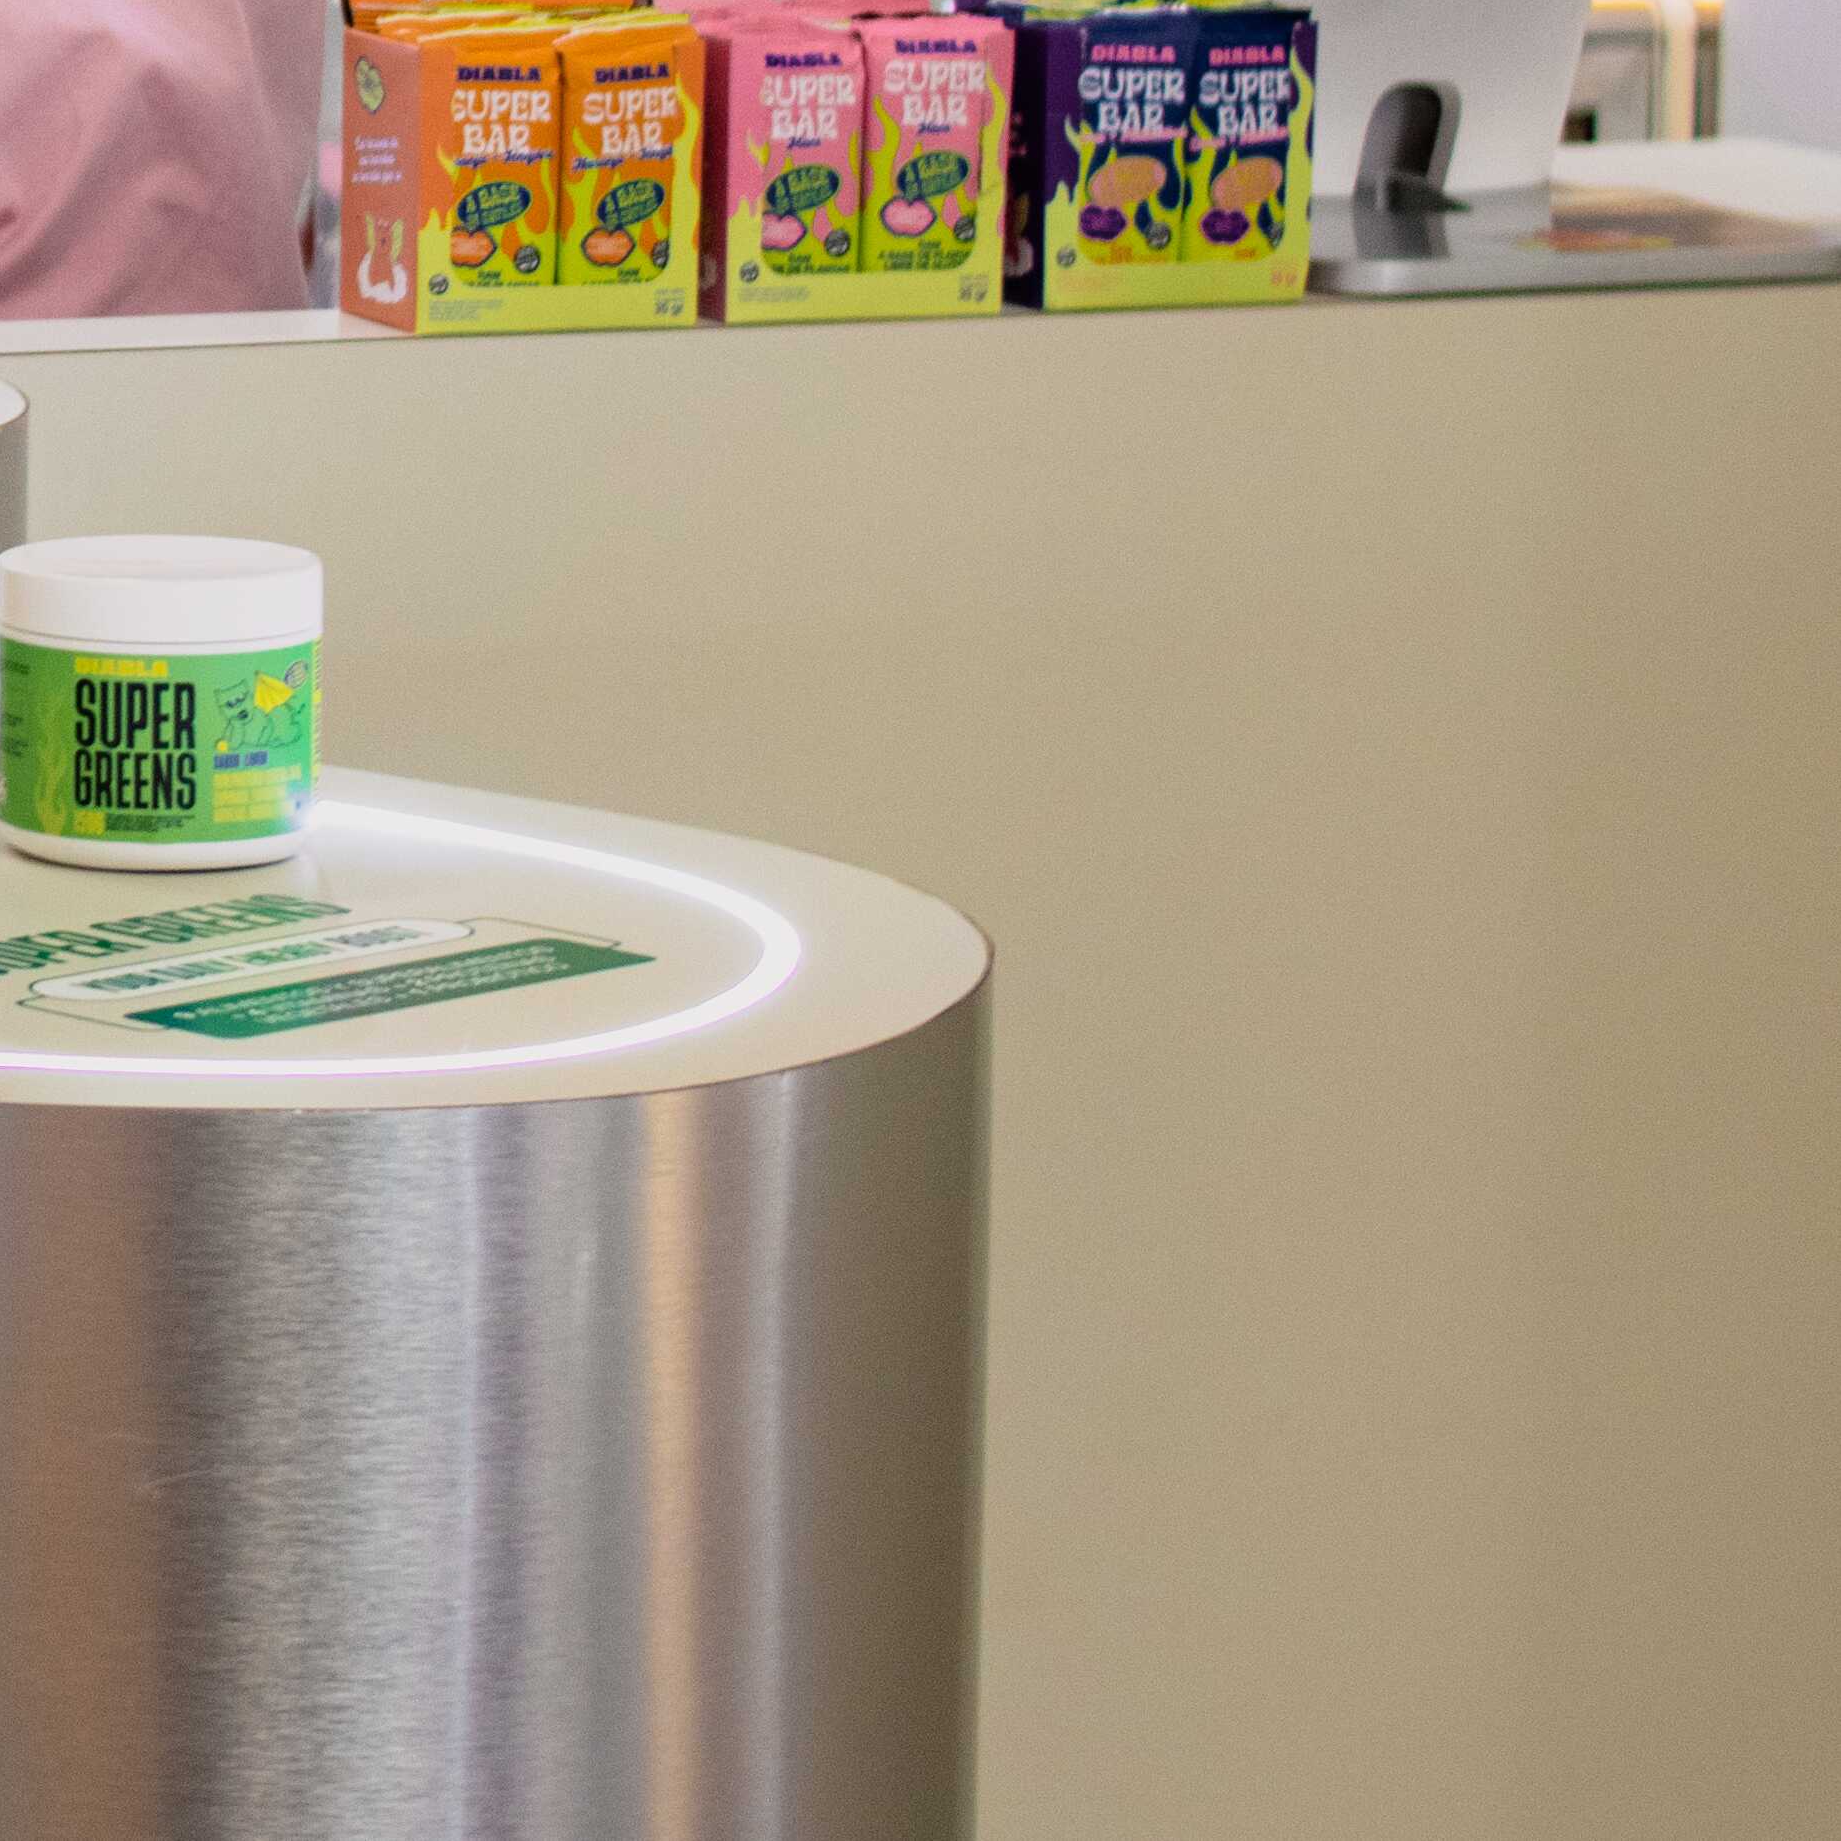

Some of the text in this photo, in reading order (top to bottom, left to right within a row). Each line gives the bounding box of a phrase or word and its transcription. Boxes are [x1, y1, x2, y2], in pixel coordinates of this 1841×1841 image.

[765, 53, 842, 68] DIABLA
[895, 39, 977, 54] DIABLA
[1091, 44, 1176, 63] DIABLA
[1209, 45, 1286, 66] DIABLA
[456, 66, 541, 83] DIABLA
[594, 64, 670, 83] DIABLA
[883, 60, 986, 93] SUPER
[1077, 68, 1185, 102] SUPER
[1199, 68, 1292, 107] SUPER
[452, 90, 551, 122] SUPER
[582, 86, 675, 124] SUPER
[760, 74, 856, 107] SUPER
[771, 107, 838, 140] BAR
[902, 92, 968, 126] BAR
[1099, 103, 1165, 137] BAR
[1218, 102, 1281, 139] BAR
[463, 124, 531, 158] BAR
[602, 122, 665, 156] BAR
[74, 678, 196, 750] SUPER
[74, 748, 196, 810] GREENS
